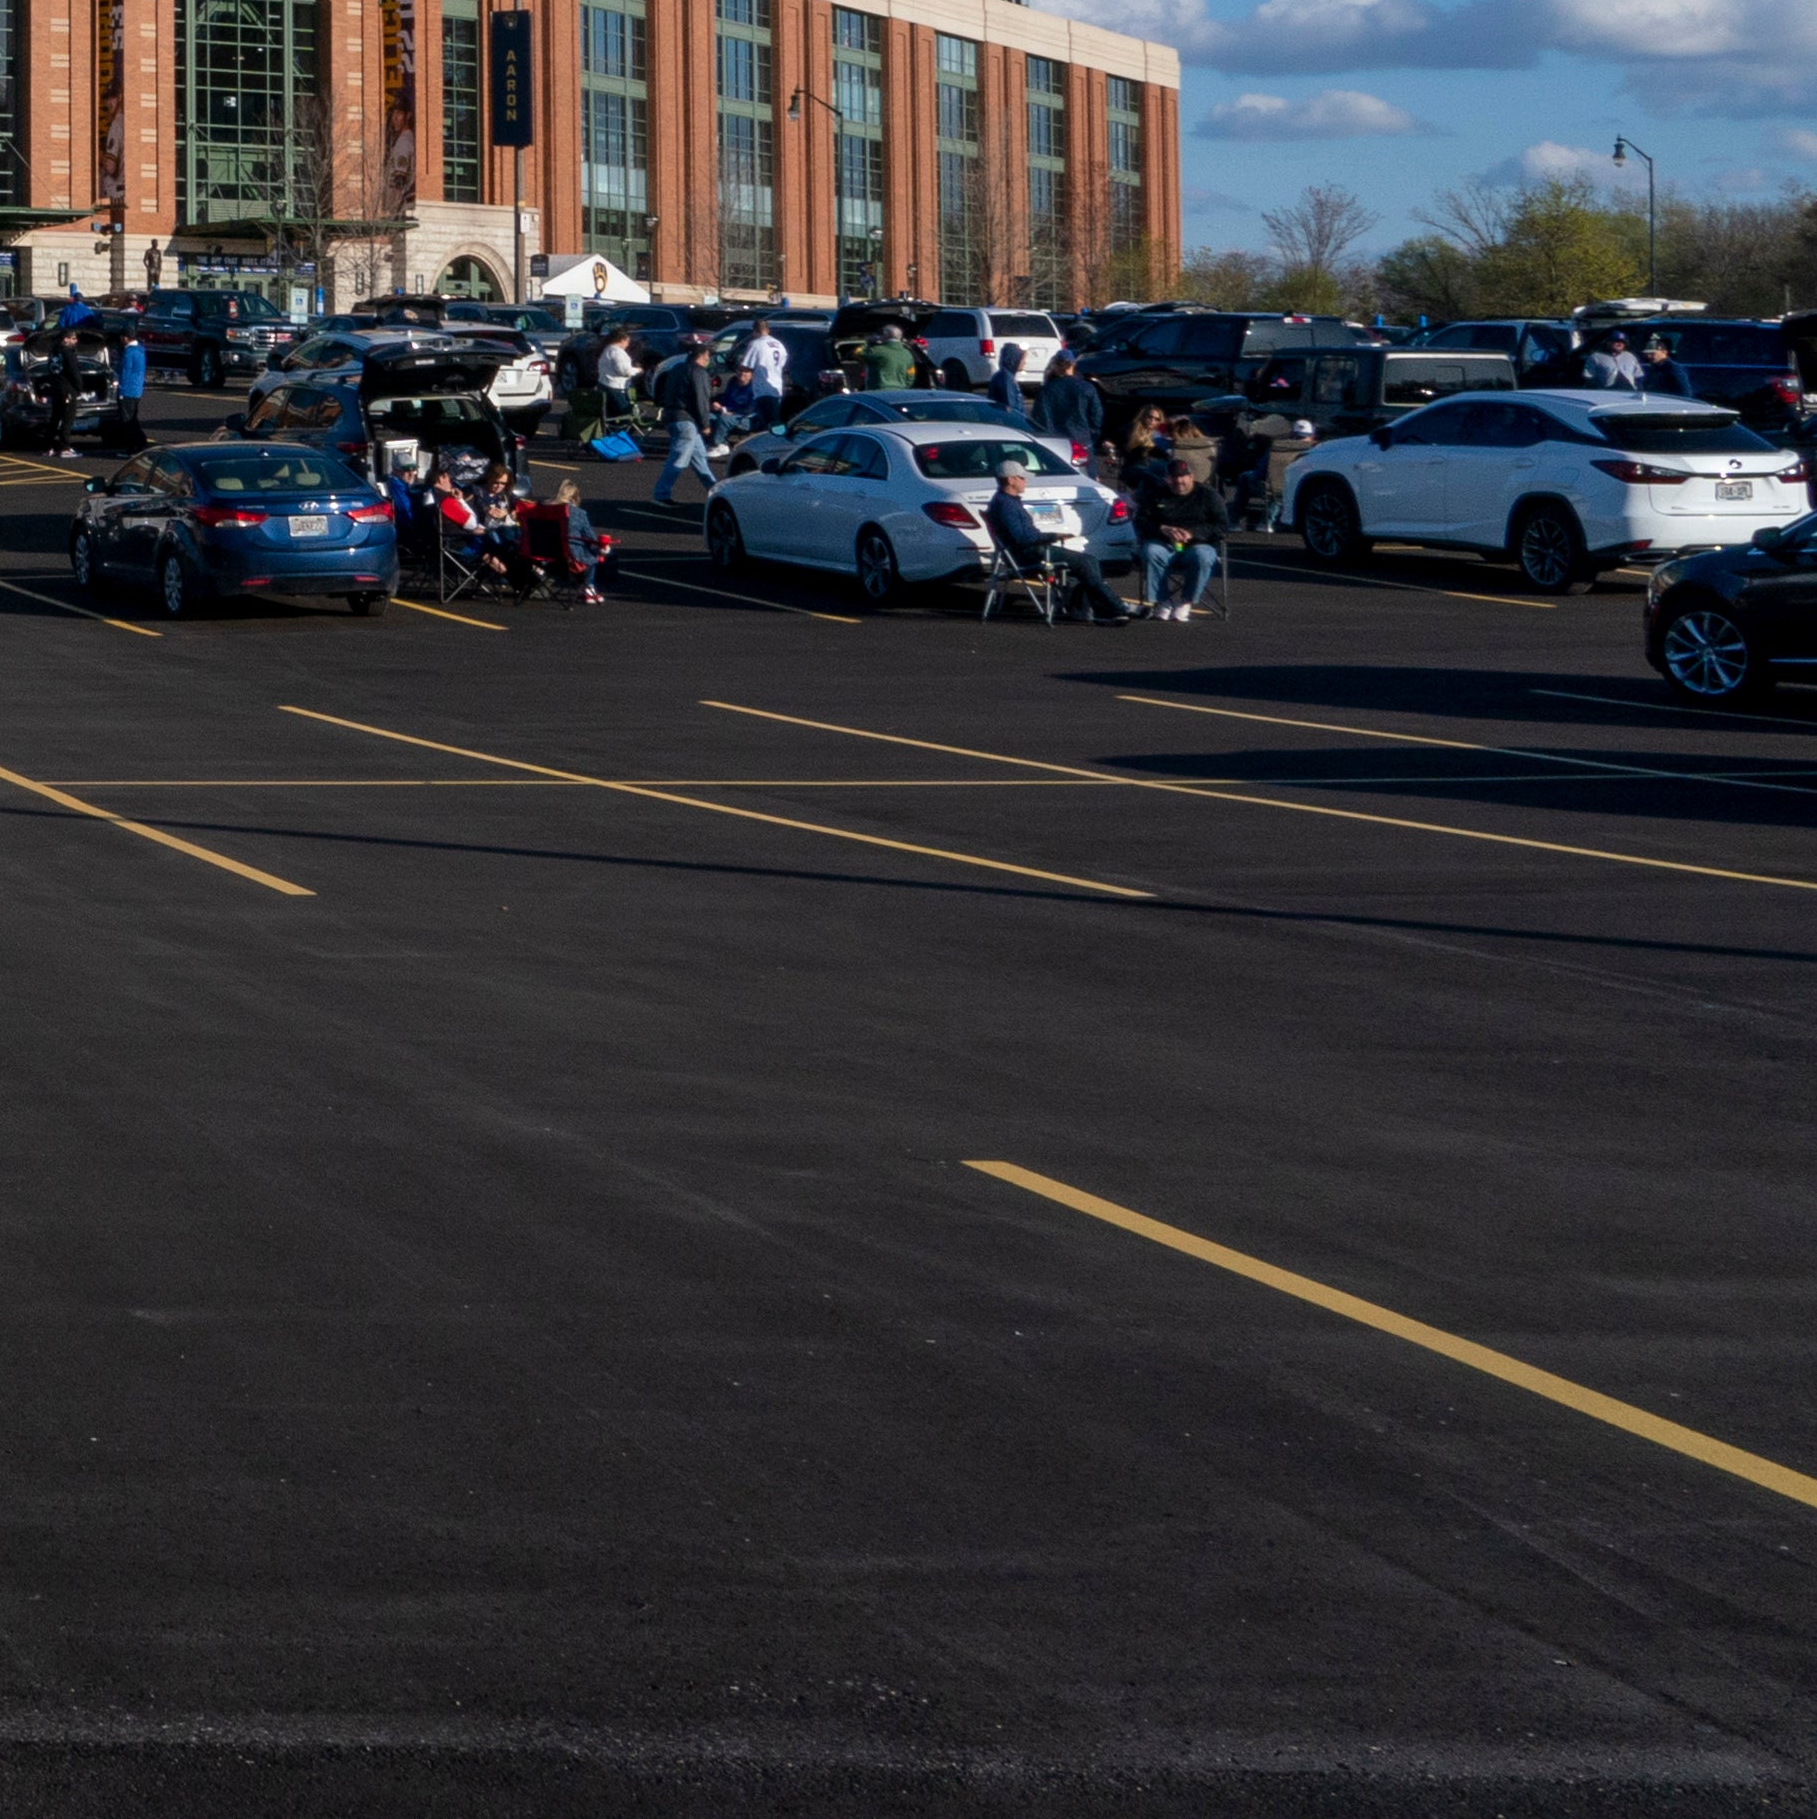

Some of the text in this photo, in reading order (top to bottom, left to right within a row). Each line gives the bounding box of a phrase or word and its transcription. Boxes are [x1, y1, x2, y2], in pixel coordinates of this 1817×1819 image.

[109, 5, 124, 50] 53
[397, 29, 415, 73] 22
[506, 49, 518, 122] AARON
[773, 350, 780, 367] 9
